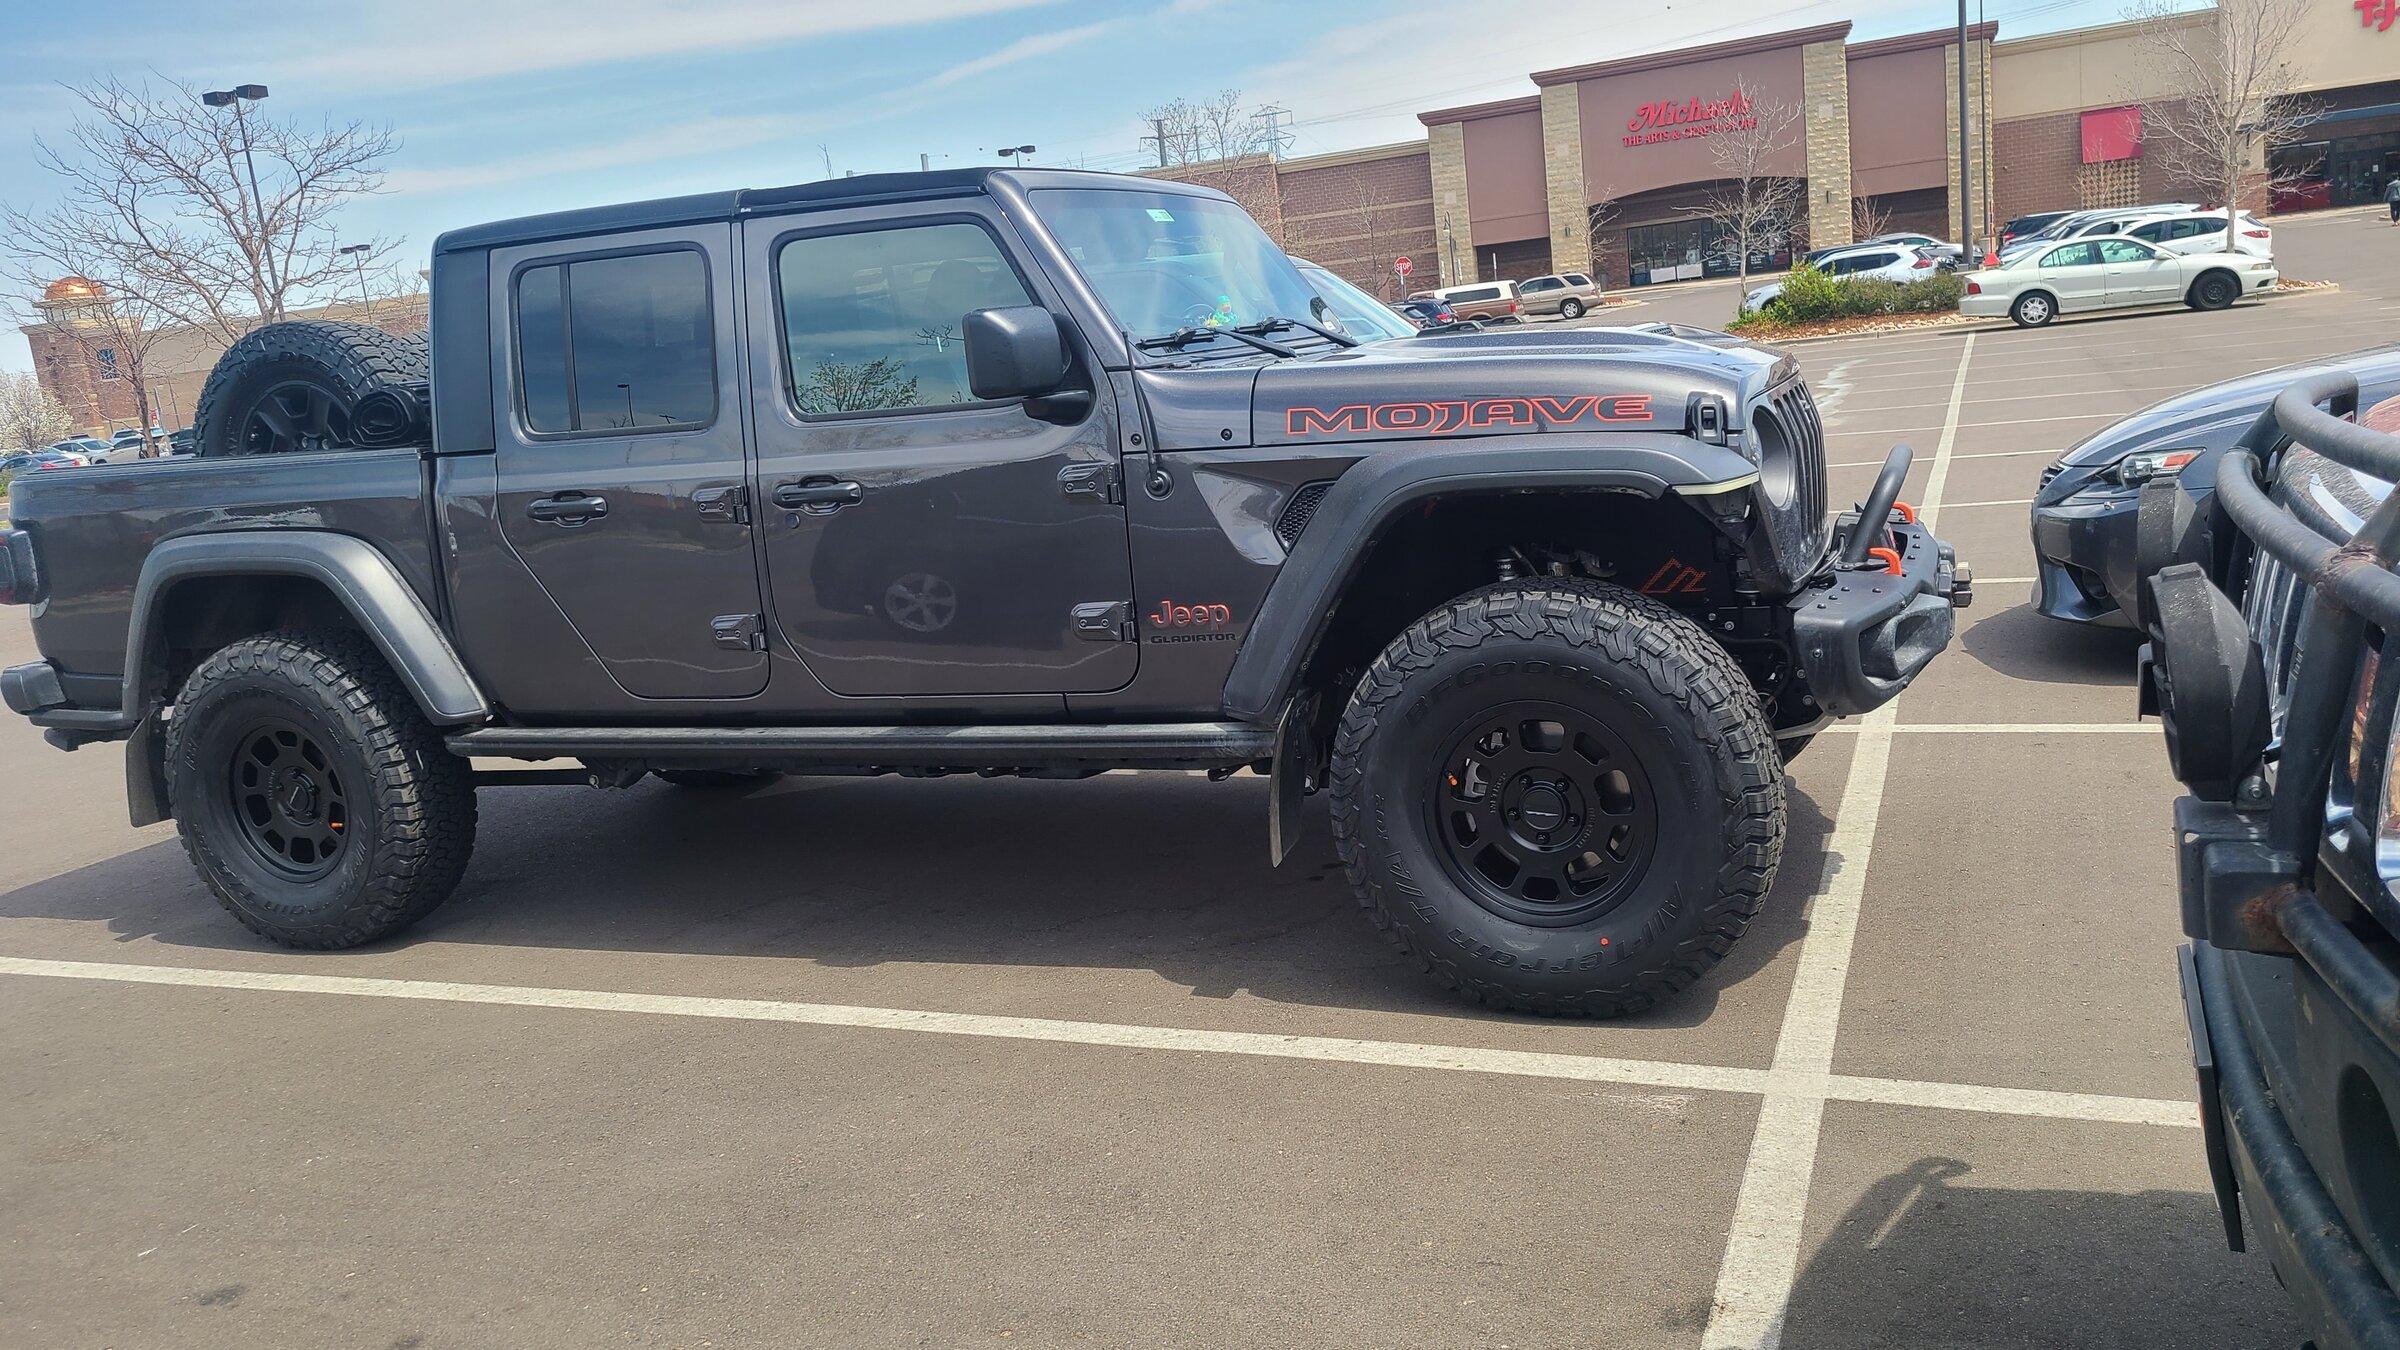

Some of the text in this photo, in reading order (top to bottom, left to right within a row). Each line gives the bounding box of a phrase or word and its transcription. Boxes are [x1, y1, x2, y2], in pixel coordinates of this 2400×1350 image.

[1628, 89, 1752, 132] Michaels
[1623, 134, 1643, 147] THE
[1645, 130, 1669, 144] ARTS
[1672, 129, 1681, 140] &
[1396, 262, 1410, 271] STOP
[1287, 395, 1653, 434] MOJAVE
[1148, 600, 1231, 632] Jeep
[1150, 633, 1236, 643] GLADIATOR
